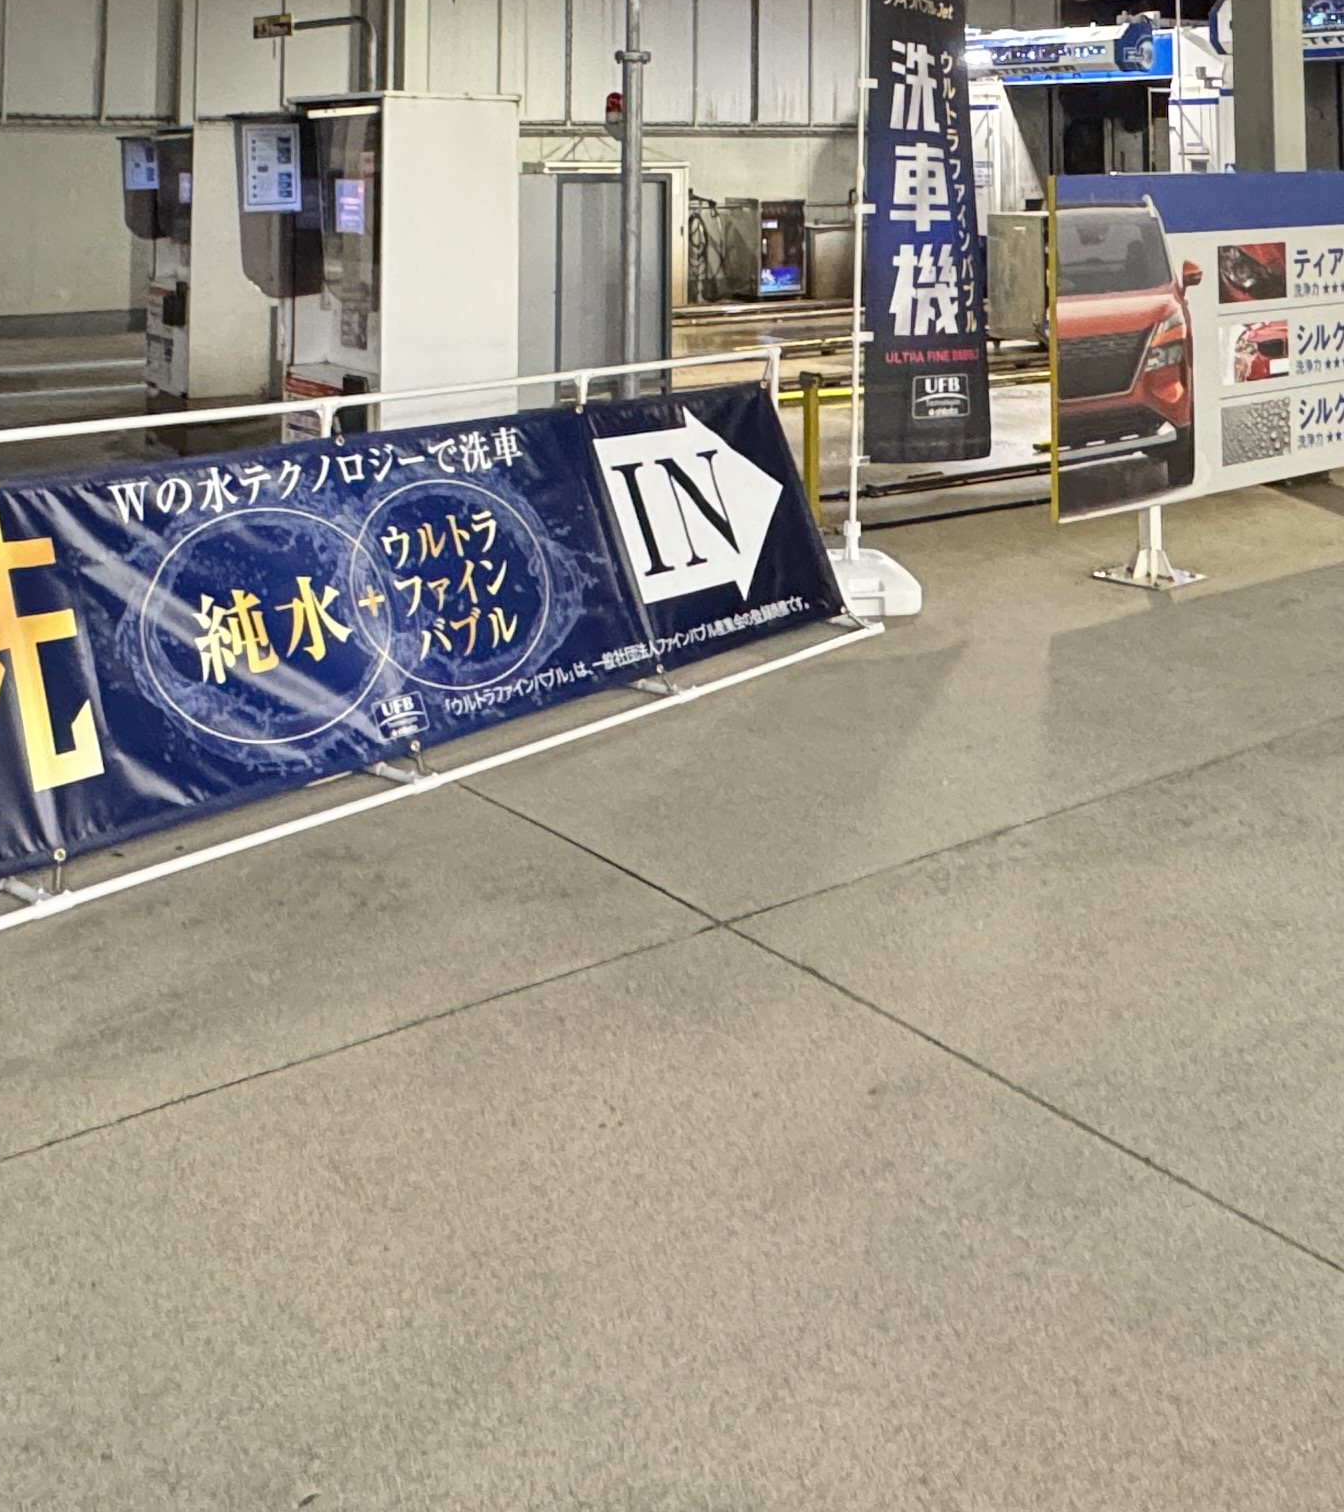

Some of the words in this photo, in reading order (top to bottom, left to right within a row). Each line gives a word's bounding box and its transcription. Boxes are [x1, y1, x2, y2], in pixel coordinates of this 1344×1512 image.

[889, 39, 960, 336] 洗車機
[940, 50, 978, 334] ウルトラファインバブル
[924, 376, 961, 394] UFB
[109, 426, 524, 524] Wの水テクノロジーで洗車
[612, 448, 740, 578] IN
[379, 509, 498, 571] ウルトラ
[394, 559, 508, 617] ファイン
[193, 575, 353, 686] 純水
[419, 607, 518, 662] バブル
[381, 696, 415, 718] UFB
